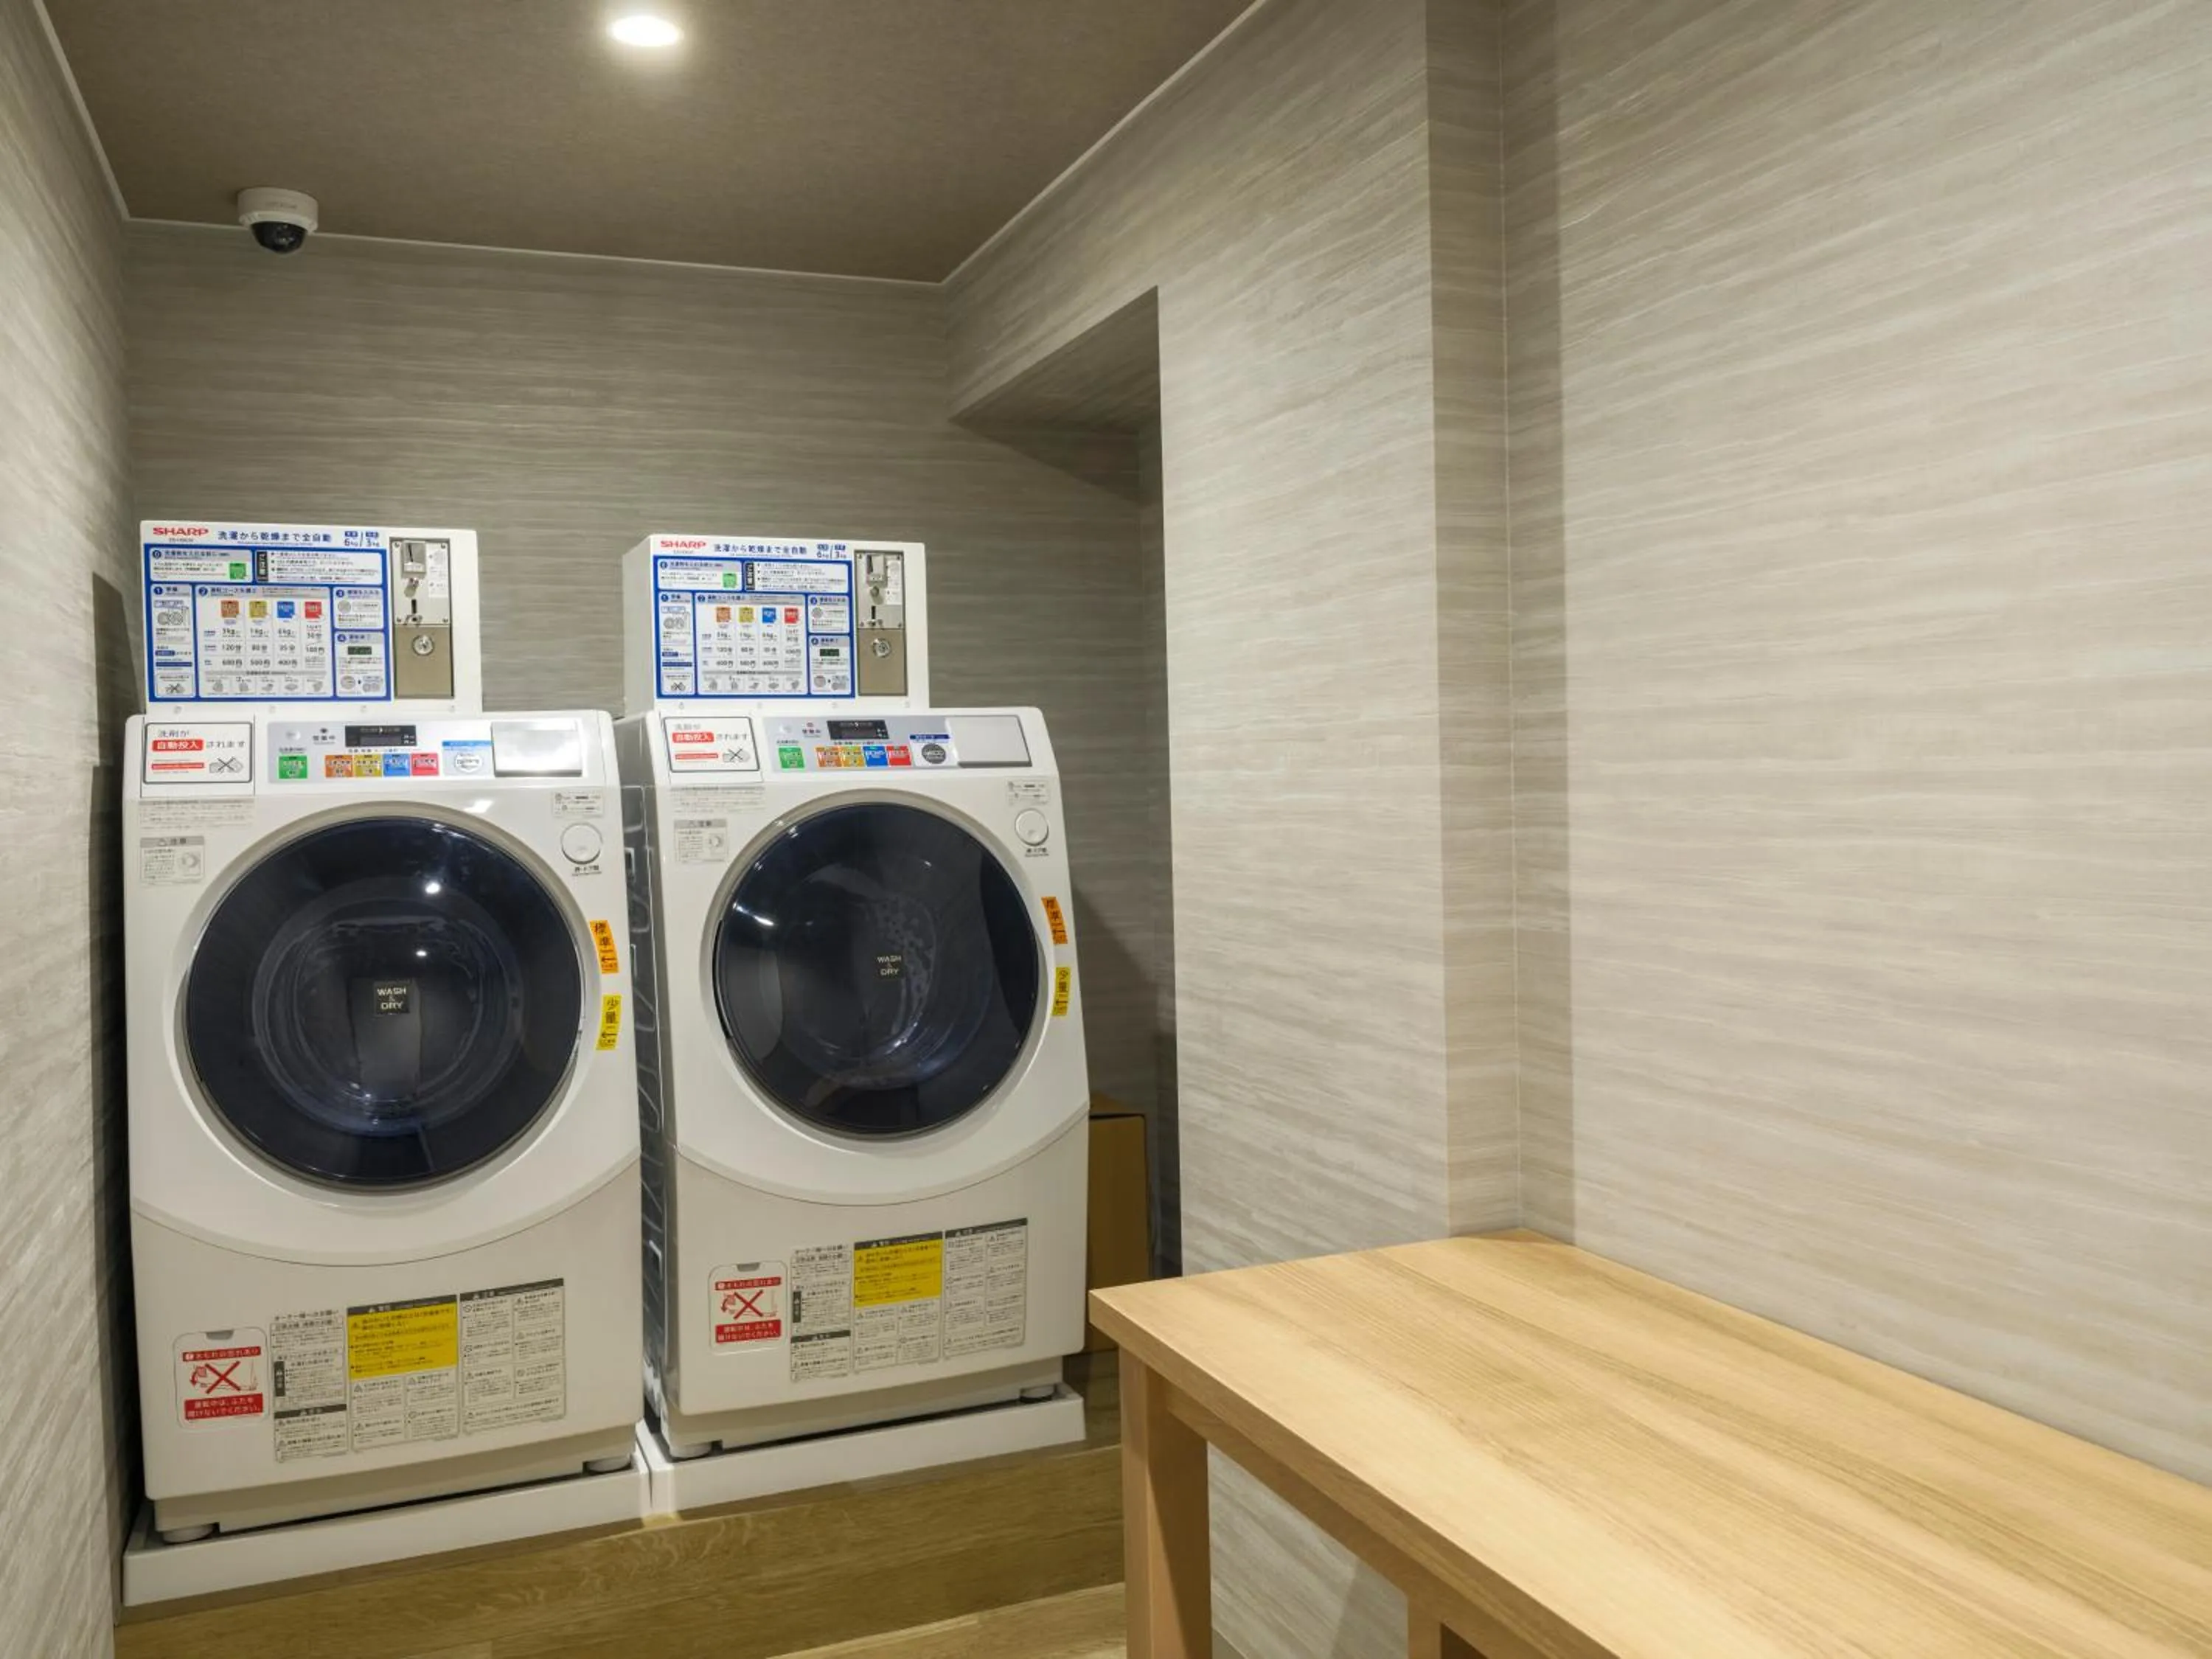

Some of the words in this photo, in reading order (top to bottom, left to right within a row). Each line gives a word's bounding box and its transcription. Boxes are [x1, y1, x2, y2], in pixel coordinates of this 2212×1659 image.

[153, 527, 209, 536] SHARP
[218, 530, 331, 542] 洗濯から乾燥まで全自動
[156, 741, 200, 750] 自動投入
[594, 922, 611, 947] 標準
[877, 955, 902, 963] WASH
[377, 987, 407, 995] WASH
[380, 1001, 404, 1009] DRY
[606, 997, 620, 1024] 少量
